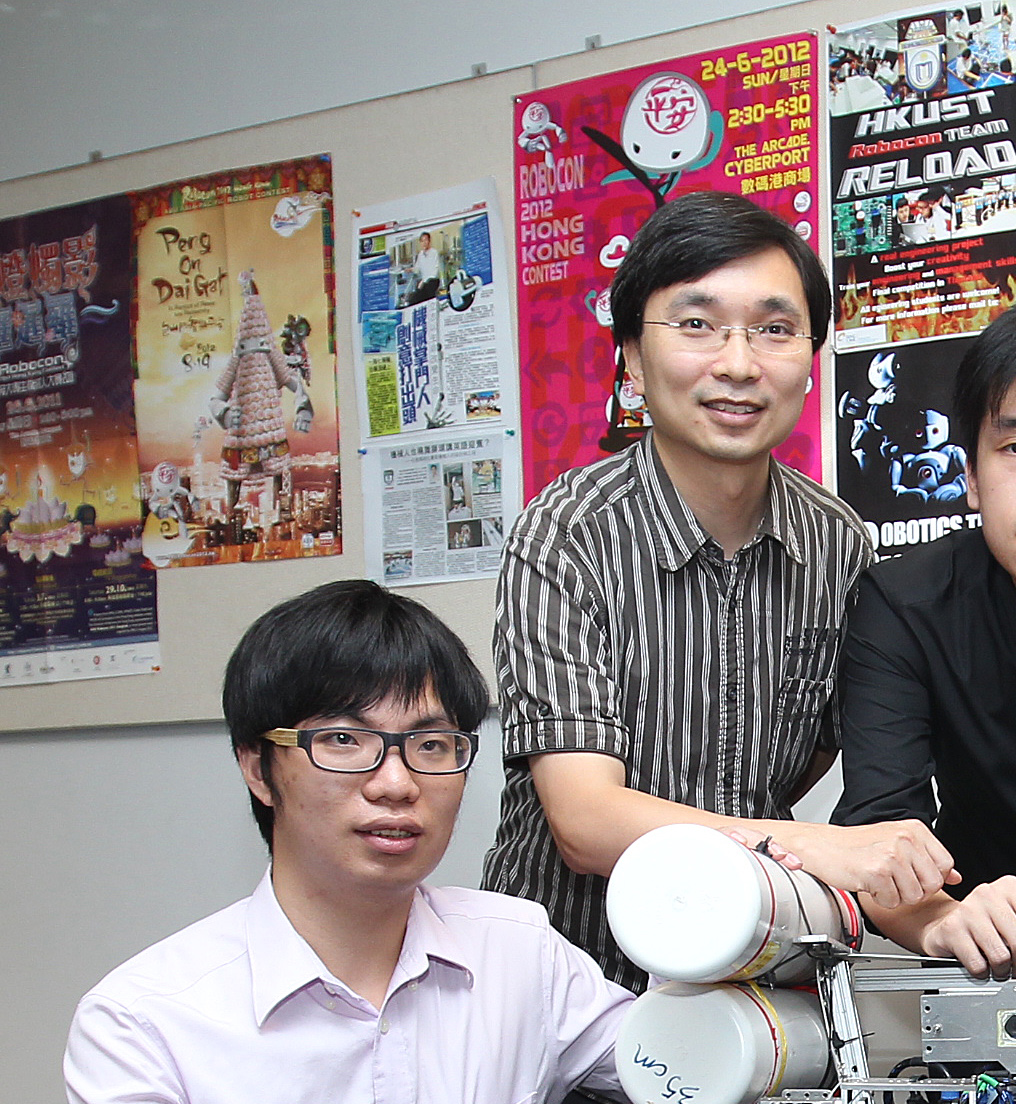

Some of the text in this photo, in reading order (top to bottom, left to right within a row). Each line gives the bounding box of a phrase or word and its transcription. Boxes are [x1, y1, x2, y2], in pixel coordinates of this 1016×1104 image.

[701, 40, 811, 81] 24-6-2012
[788, 79, 811, 95] 下午
[728, 94, 811, 128] 2:30-5:30
[791, 116, 811, 131] PM
[854, 90, 996, 138] HKUST
[944, 119, 1009, 142] TEAM
[725, 147, 811, 177] CYBERPORT
[734, 143, 757, 159] THE
[520, 154, 584, 199] ROBOCON
[521, 199, 553, 221] 2012
[521, 214, 584, 242] HONG
[521, 236, 585, 264] KONG
[870, 255, 879, 264] A
[952, 238, 985, 252] project
[884, 252, 970, 273] Boost your creativity
[179, 255, 200, 275] On
[522, 261, 569, 285] CONTEST
[922, 270, 935, 279] and
[151, 277, 190, 304] Dai
[947, 292, 961, 301] are
[861, 315, 874, 325] For
[897, 306, 940, 321] information
[942, 303, 967, 315] please
[969, 300, 986, 310] mail
[634, 1043, 667, 1077] cm
